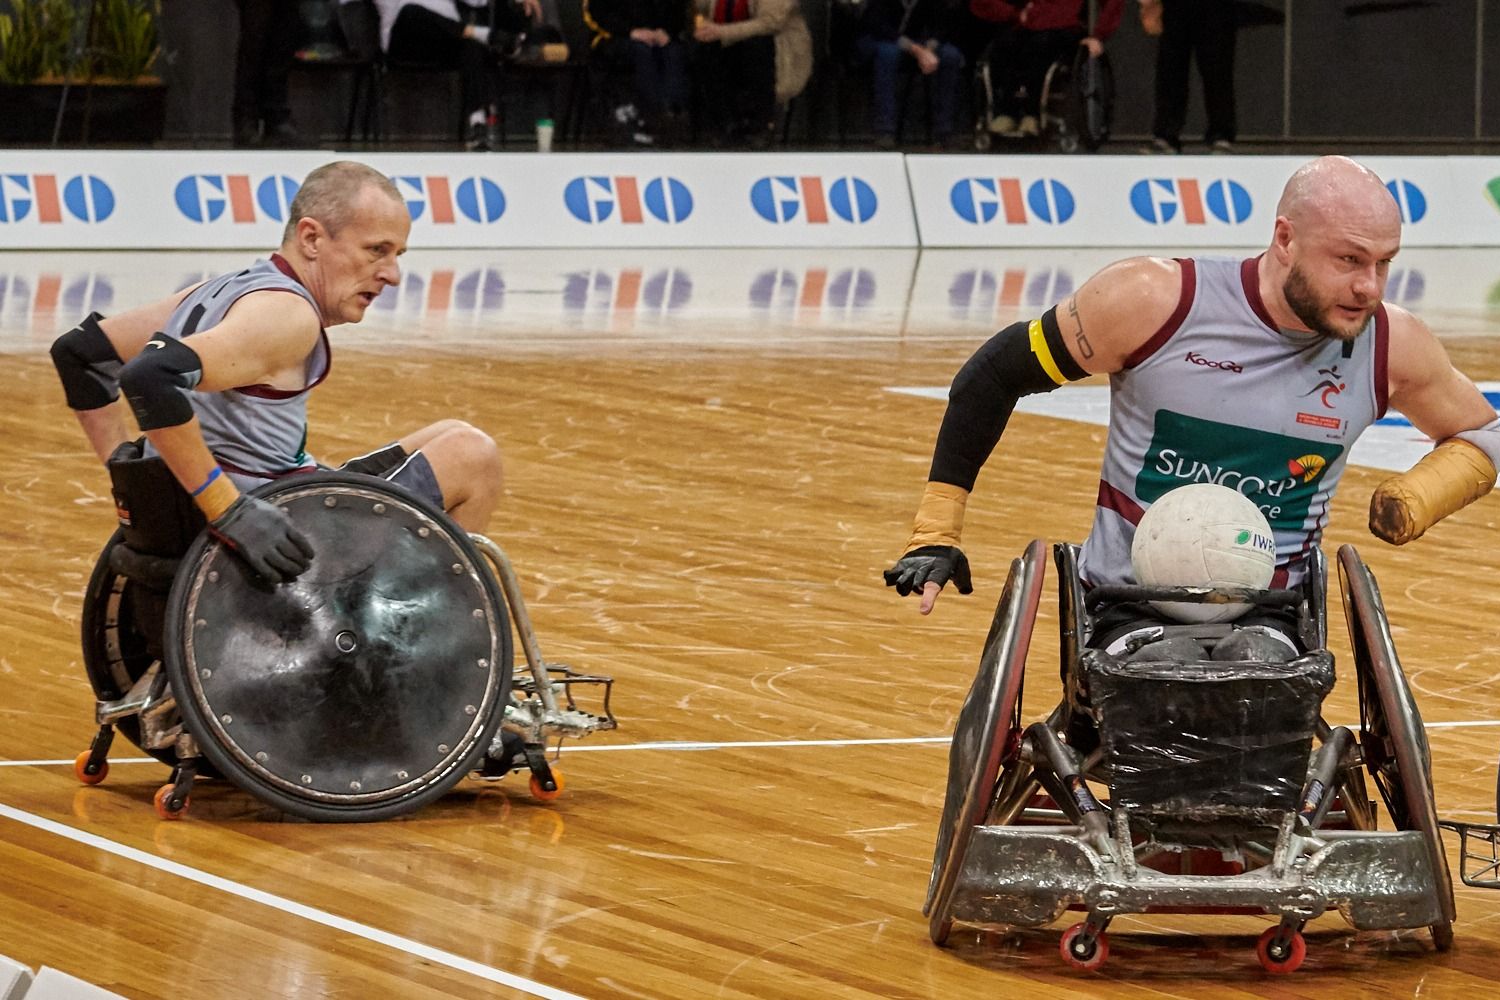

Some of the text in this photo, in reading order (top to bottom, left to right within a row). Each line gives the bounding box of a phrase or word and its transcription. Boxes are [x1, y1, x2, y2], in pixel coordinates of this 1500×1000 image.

[564, 176, 694, 223] GIO
[751, 176, 877, 223] GIO
[950, 177, 1075, 224] GIO
[1130, 178, 1253, 225] GIO
[1185, 351, 1244, 374] KooGa
[1253, 533, 1276, 556] IWR
